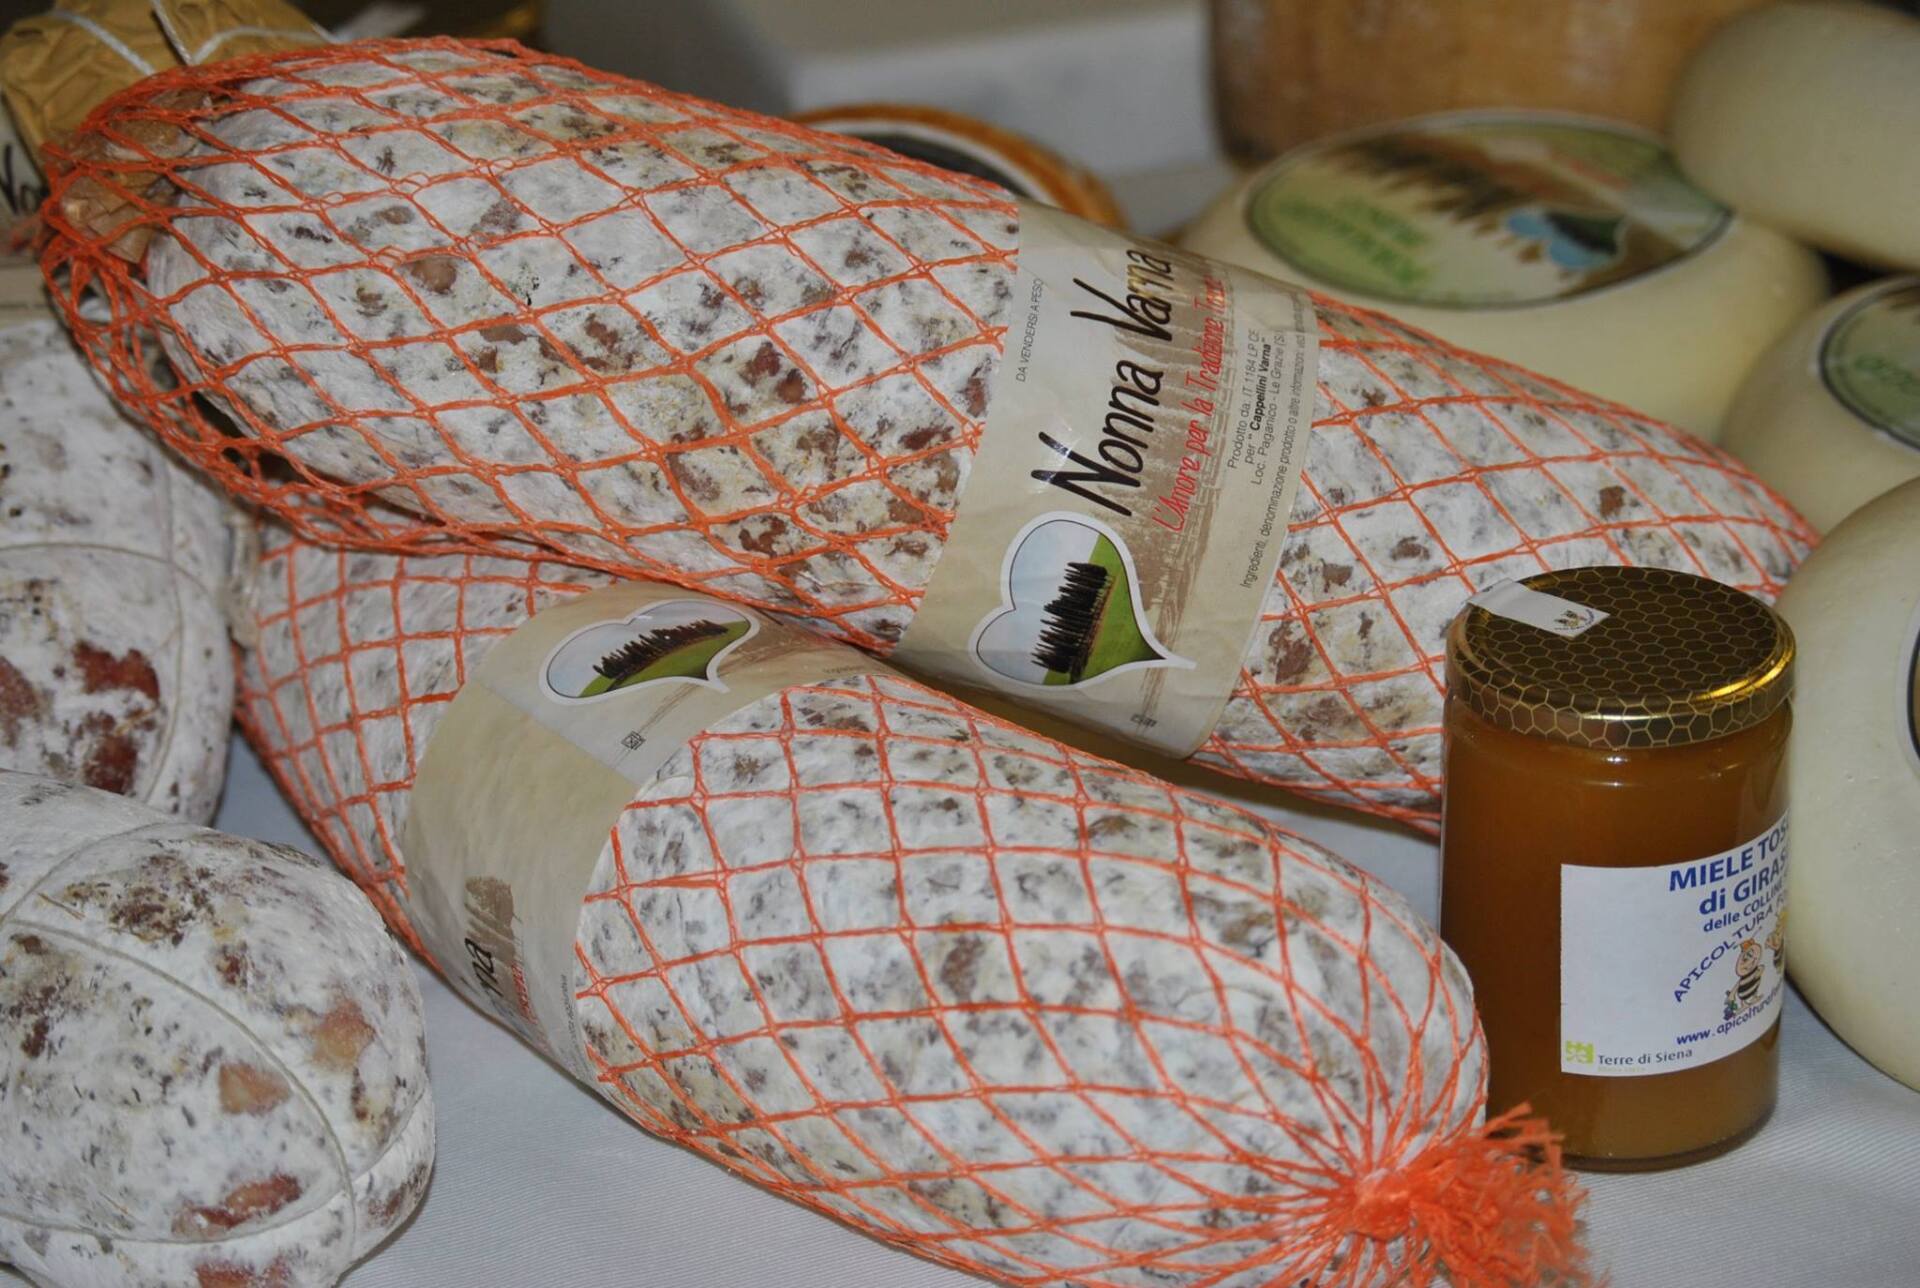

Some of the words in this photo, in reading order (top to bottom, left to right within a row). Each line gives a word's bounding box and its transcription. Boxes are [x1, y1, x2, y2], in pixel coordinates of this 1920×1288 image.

[1030, 304, 1040, 313] A
[1031, 278, 1044, 303] PESO
[1070, 249, 1175, 342] Varna
[1020, 313, 1038, 363] VENDERSI
[1184, 317, 1225, 393] Tradizione
[1015, 366, 1028, 383] DA
[1269, 381, 1281, 395] Le
[1180, 397, 1216, 417] la
[1227, 420, 1248, 469] Prodotto
[1247, 343, 1258, 358] LP
[1031, 360, 1164, 517] Nonna
[1185, 419, 1213, 457] per
[1257, 403, 1278, 457] Paganico
[1280, 424, 1297, 466] prodotto
[1244, 444, 1257, 465] per
[1250, 460, 1266, 486] Loc.
[1152, 455, 1201, 532] L'Amore
[1669, 847, 1754, 892] MIELE
[1699, 888, 1726, 915] di
[1703, 911, 1741, 933] delle
[1674, 903, 1774, 1002] APICOLTURA
[1597, 1054, 1634, 1066] Terre
[1637, 1053, 1652, 1065] di
[1655, 1048, 1693, 1063] Siena
